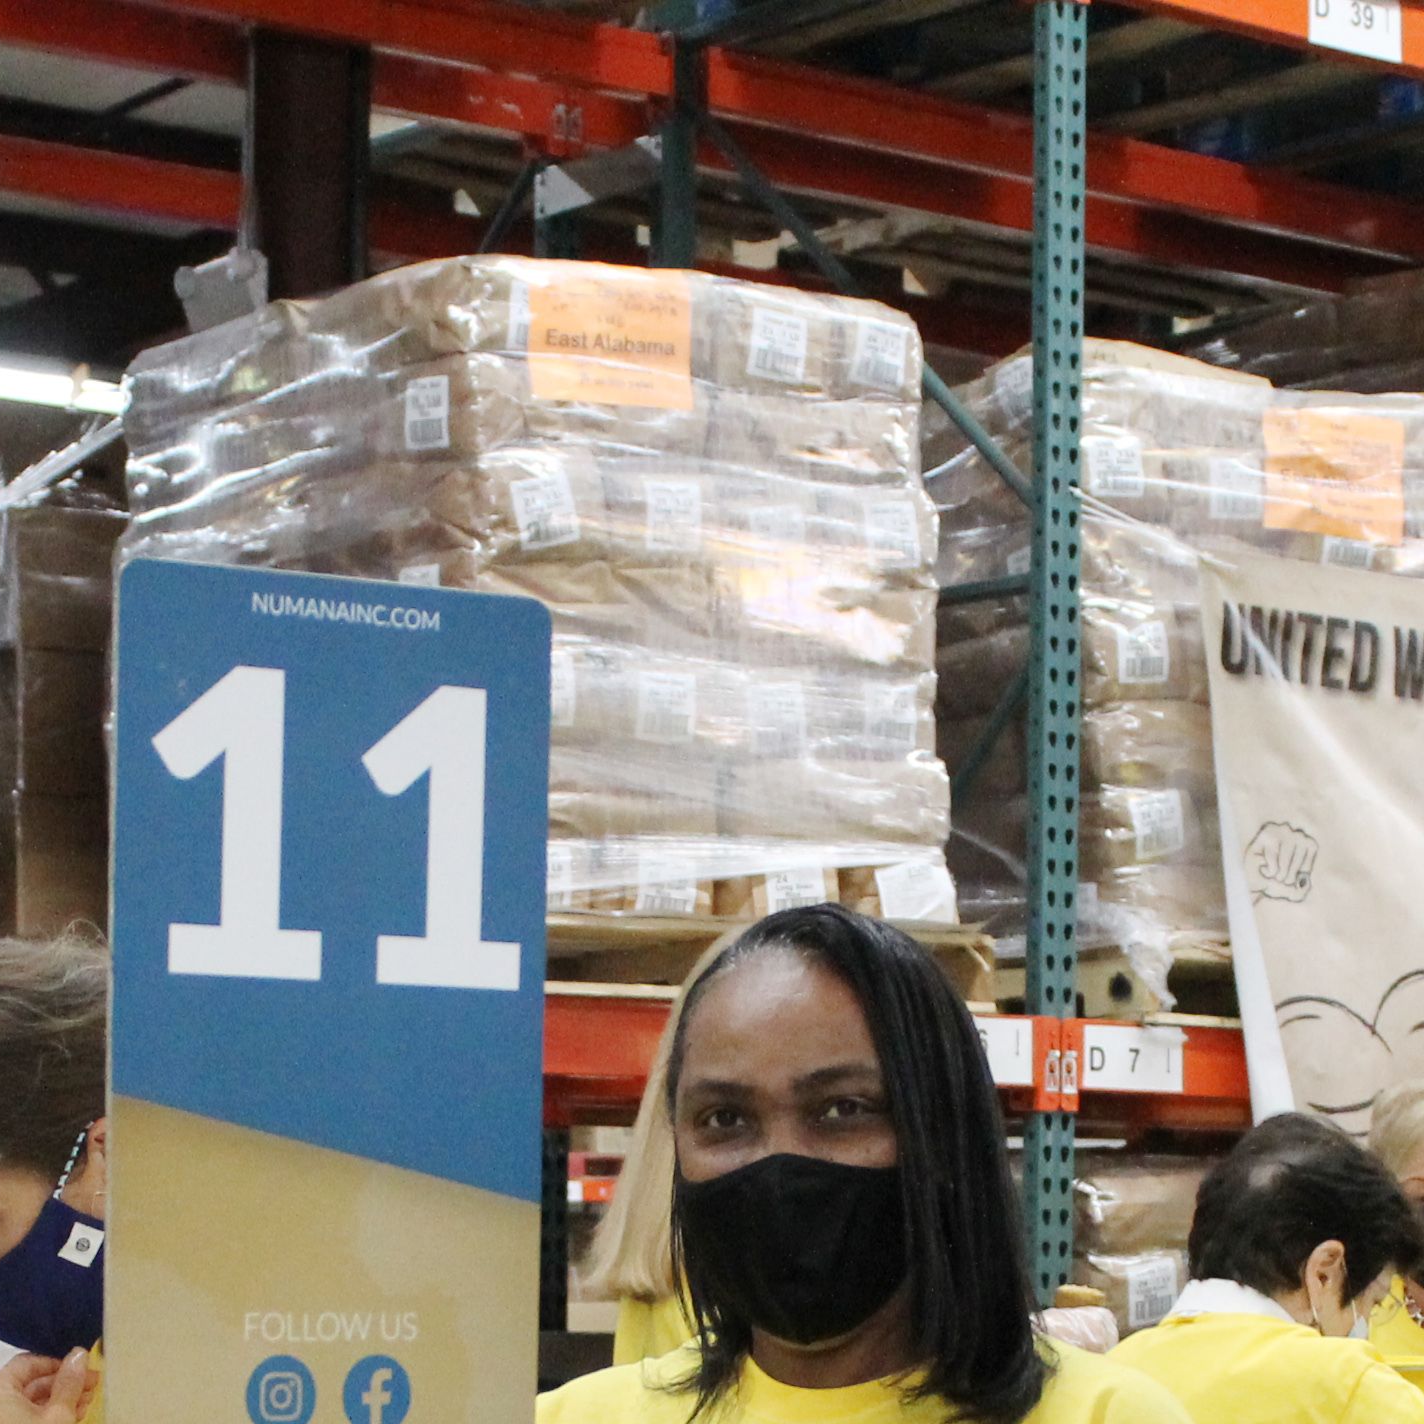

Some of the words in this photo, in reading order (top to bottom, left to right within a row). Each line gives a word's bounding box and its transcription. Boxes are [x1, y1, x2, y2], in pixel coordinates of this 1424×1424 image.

[1350, 2, 1374, 30] 39
[544, 328, 589, 349] East
[592, 332, 676, 356] Alabama
[250, 590, 443, 632] NUMANAINC.COM
[1220, 600, 1380, 693] UNITED
[1089, 1046, 1106, 1072] D
[1128, 1047, 1141, 1073] 7
[243, 1311, 372, 1342] FOLLOW
[379, 1310, 418, 1341] US
